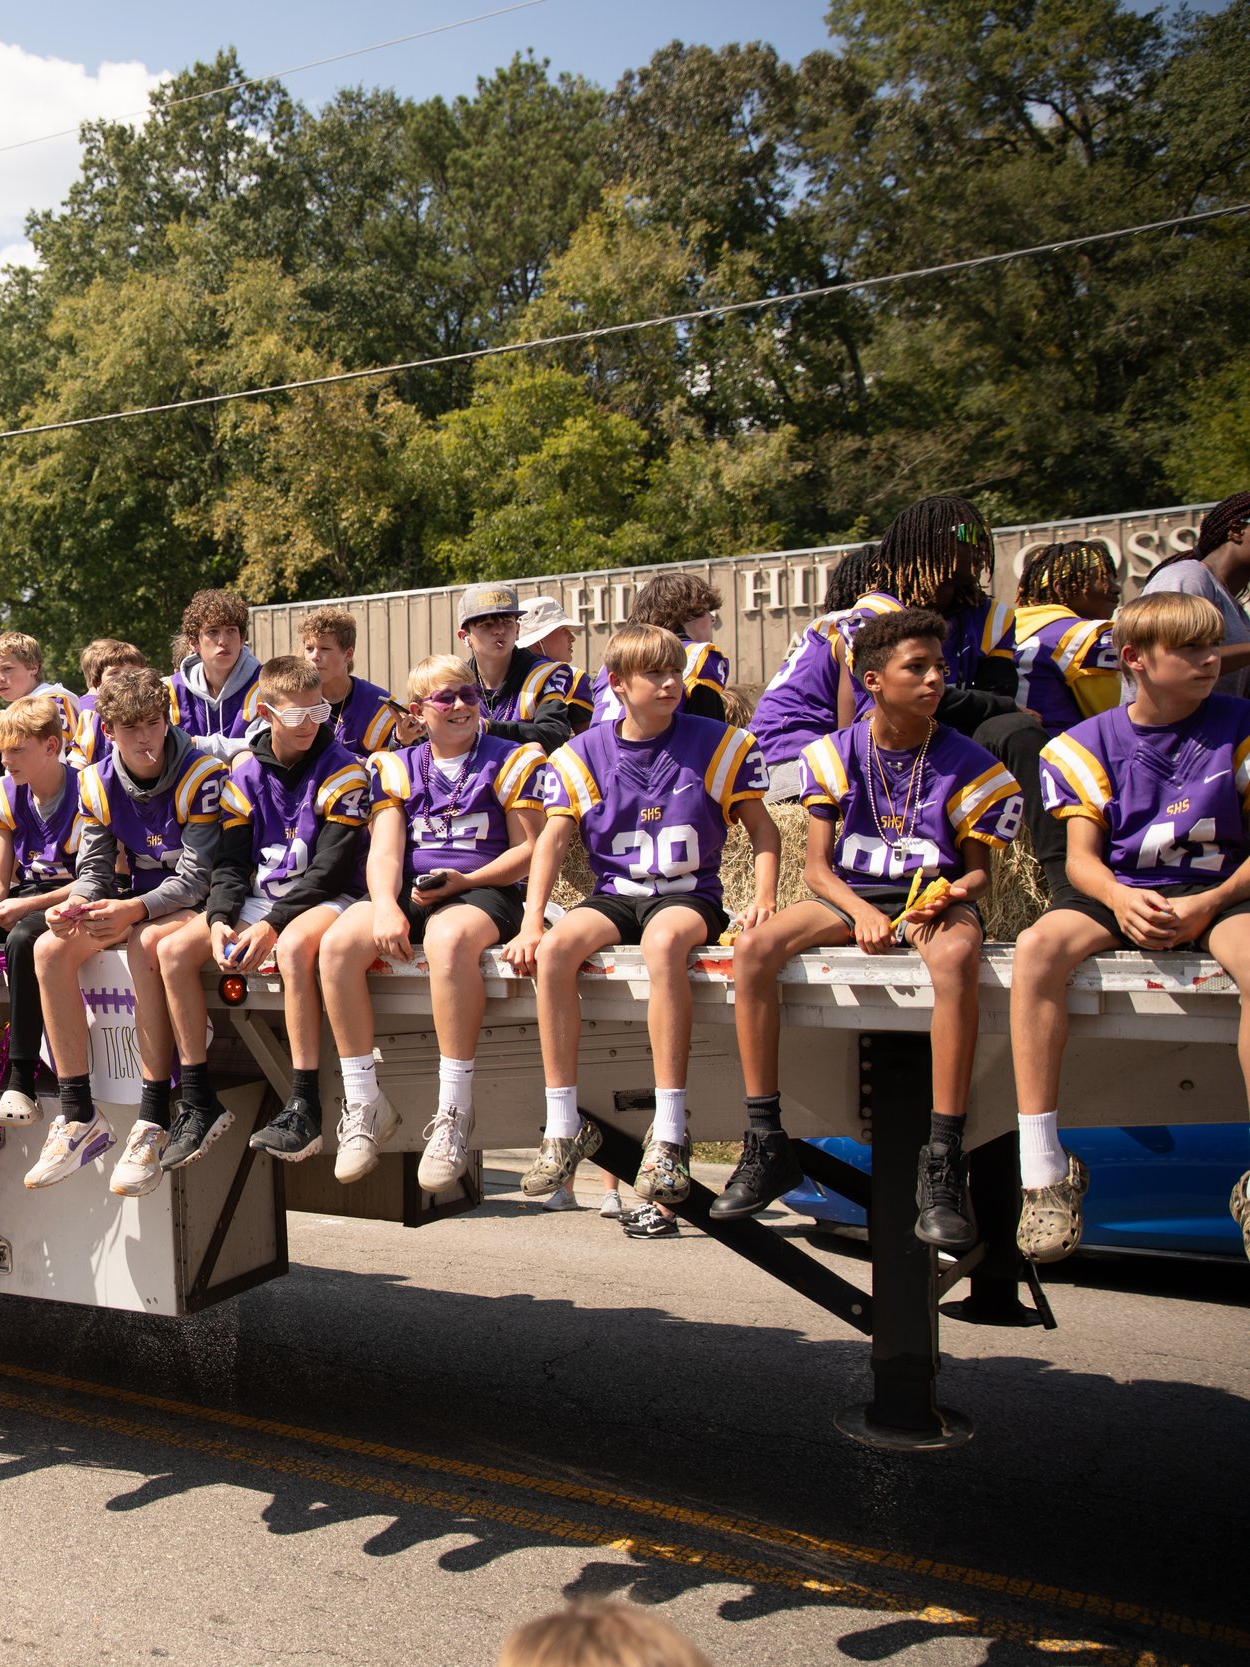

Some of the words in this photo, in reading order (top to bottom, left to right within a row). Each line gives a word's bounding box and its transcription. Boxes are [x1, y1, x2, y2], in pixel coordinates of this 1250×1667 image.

[640, 806, 663, 823] SHS
[1166, 798, 1191, 817] SHS
[880, 814, 904, 829] SHS
[995, 796, 1025, 839] 8
[145, 834, 163, 848] SHS
